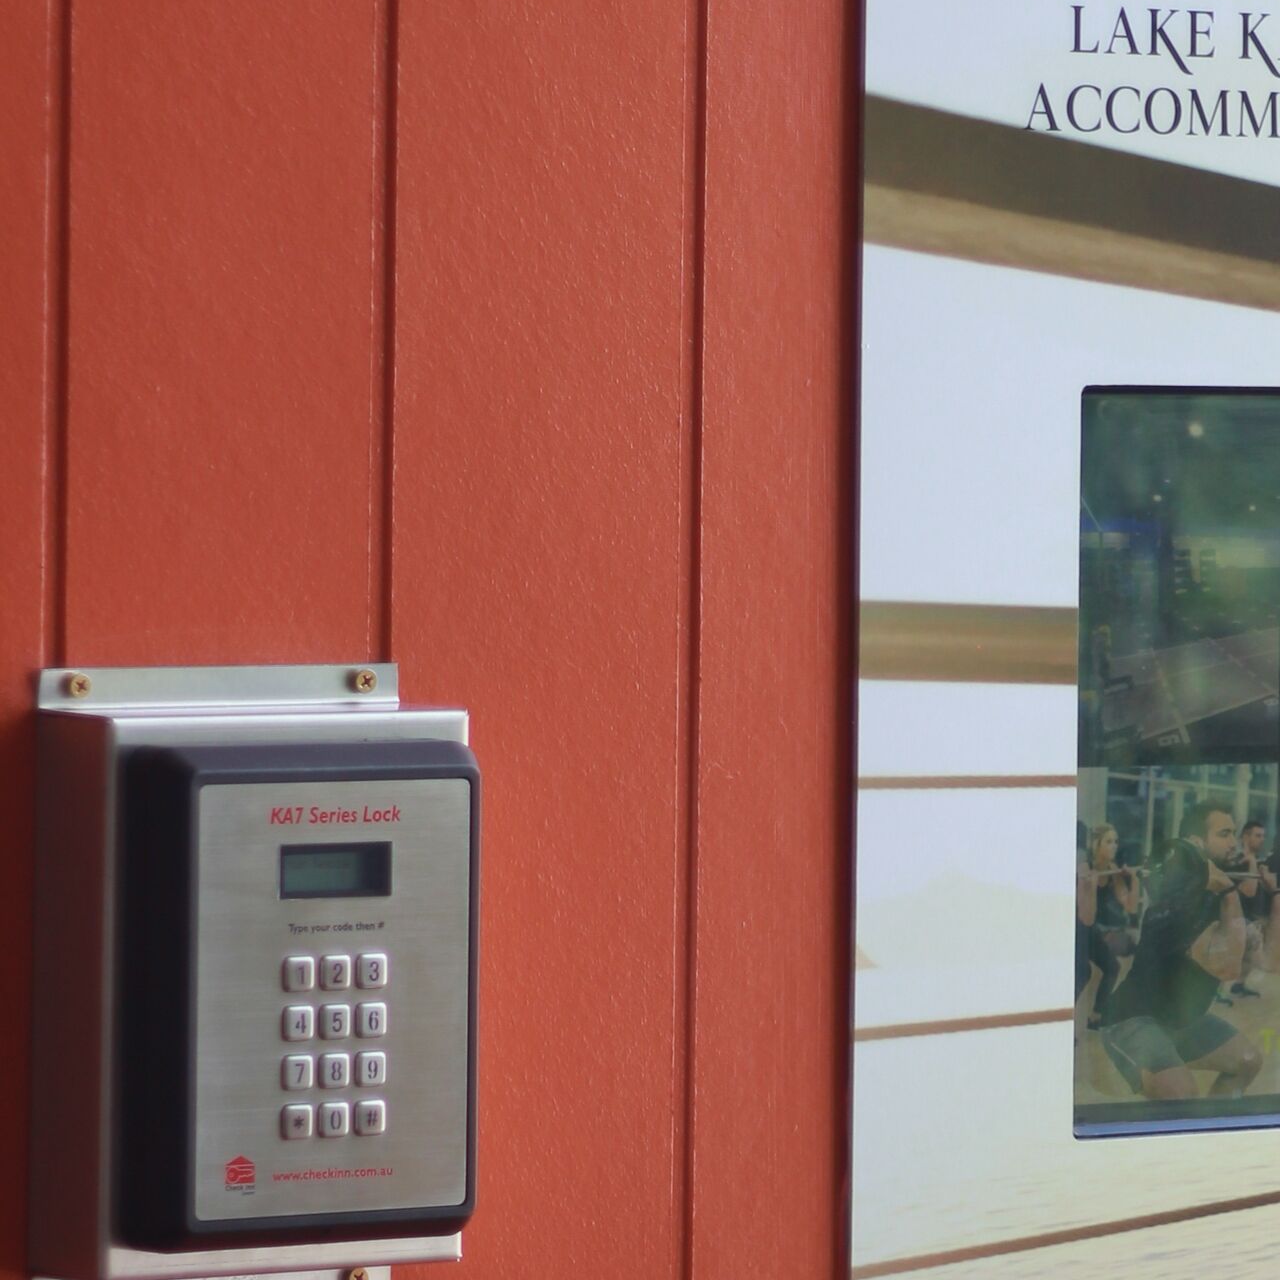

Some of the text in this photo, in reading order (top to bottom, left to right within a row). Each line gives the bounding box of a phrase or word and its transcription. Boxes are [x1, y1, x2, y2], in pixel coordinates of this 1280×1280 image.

[1069, 4, 1216, 76] LAKE
[270, 805, 401, 825] KA7 Series Lock
[288, 923, 309, 935] Type
[310, 924, 330, 934] your
[332, 922, 353, 931] code
[355, 921, 375, 930] then
[296, 961, 380, 985] 1 2 3
[295, 1010, 380, 1034] 4 5 6
[295, 1059, 378, 1083] 7 8 9
[330, 1109, 342, 1130] 0
[272, 1166, 393, 1182] www.checkinn.com.au
